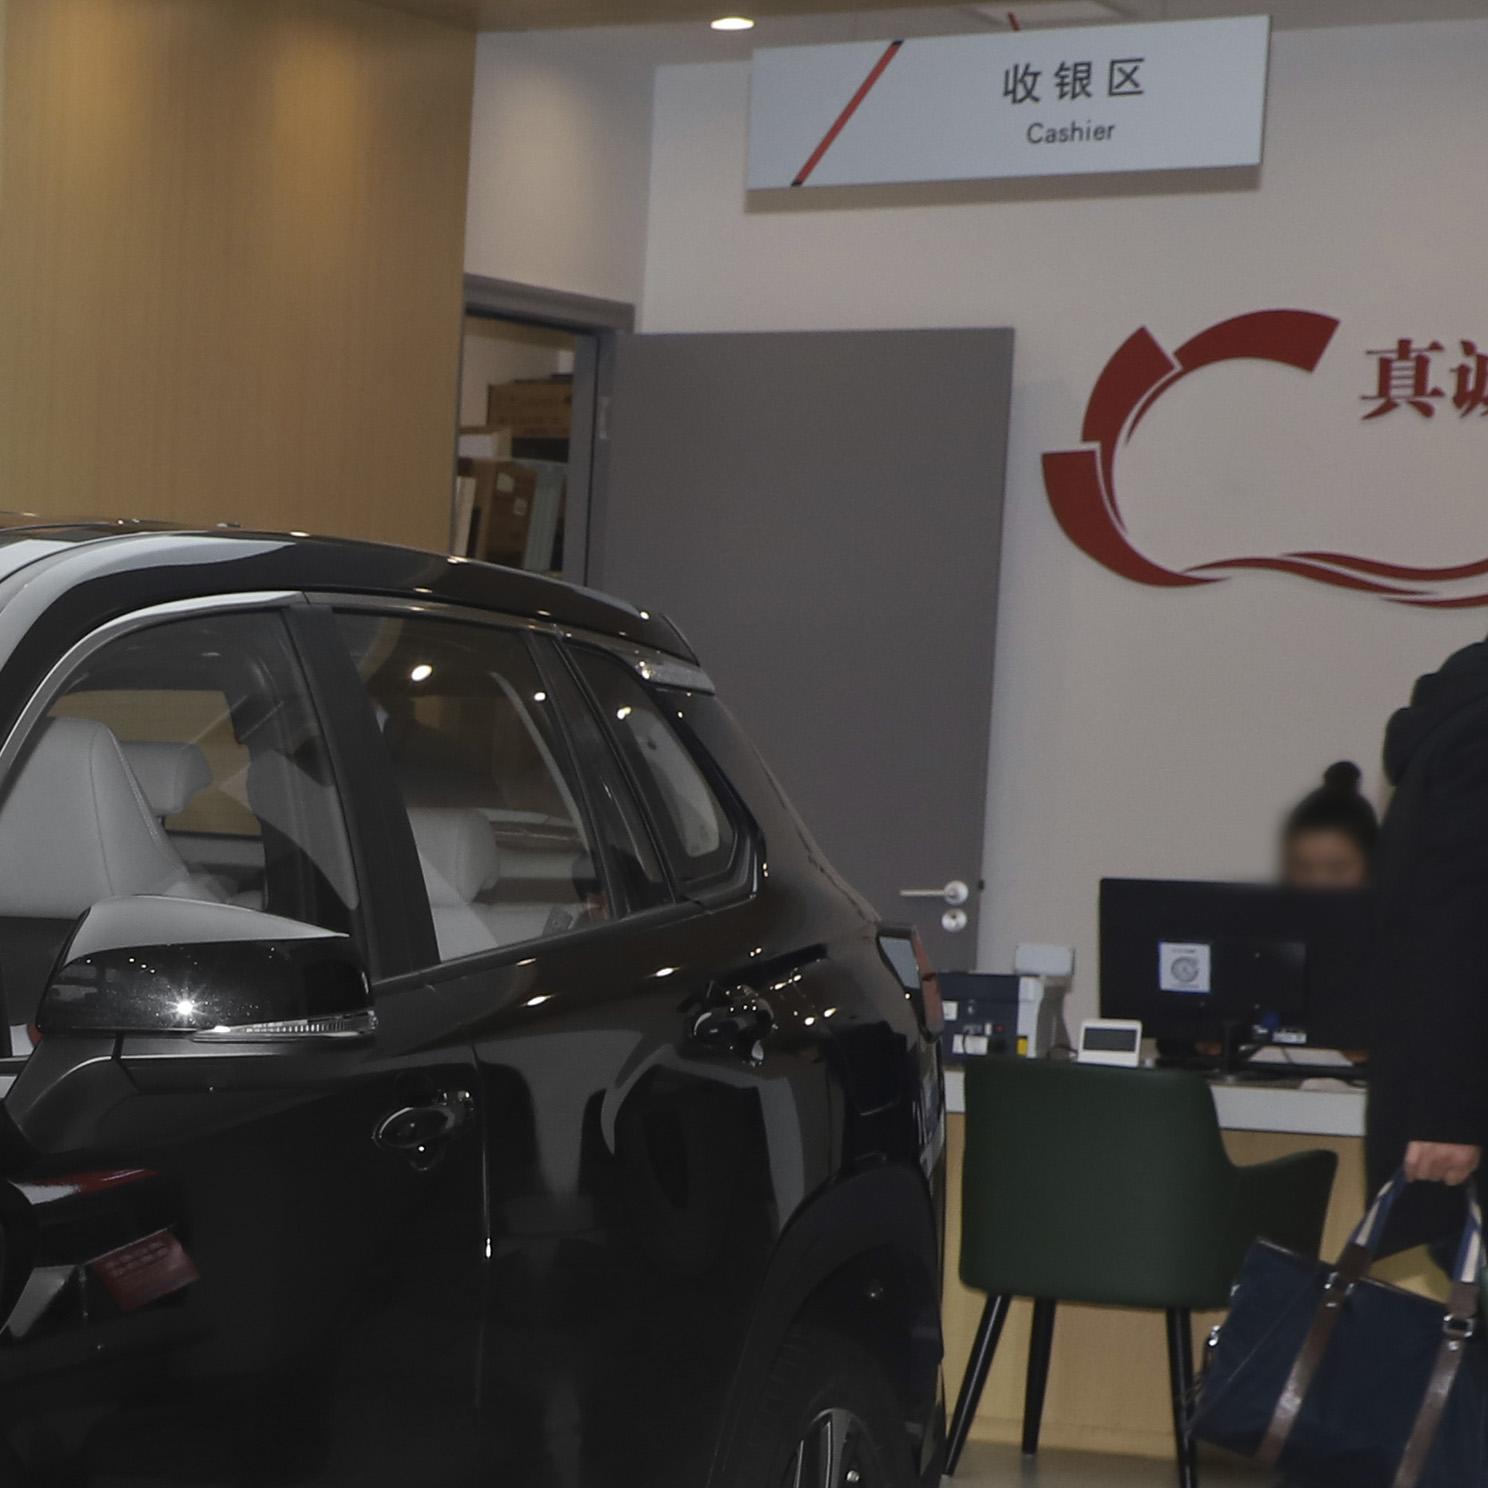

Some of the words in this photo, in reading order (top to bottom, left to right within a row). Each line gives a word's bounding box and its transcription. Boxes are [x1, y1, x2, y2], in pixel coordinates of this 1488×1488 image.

[1003, 58, 1145, 104] 收银区
[1026, 119, 1115, 144] Cashier
